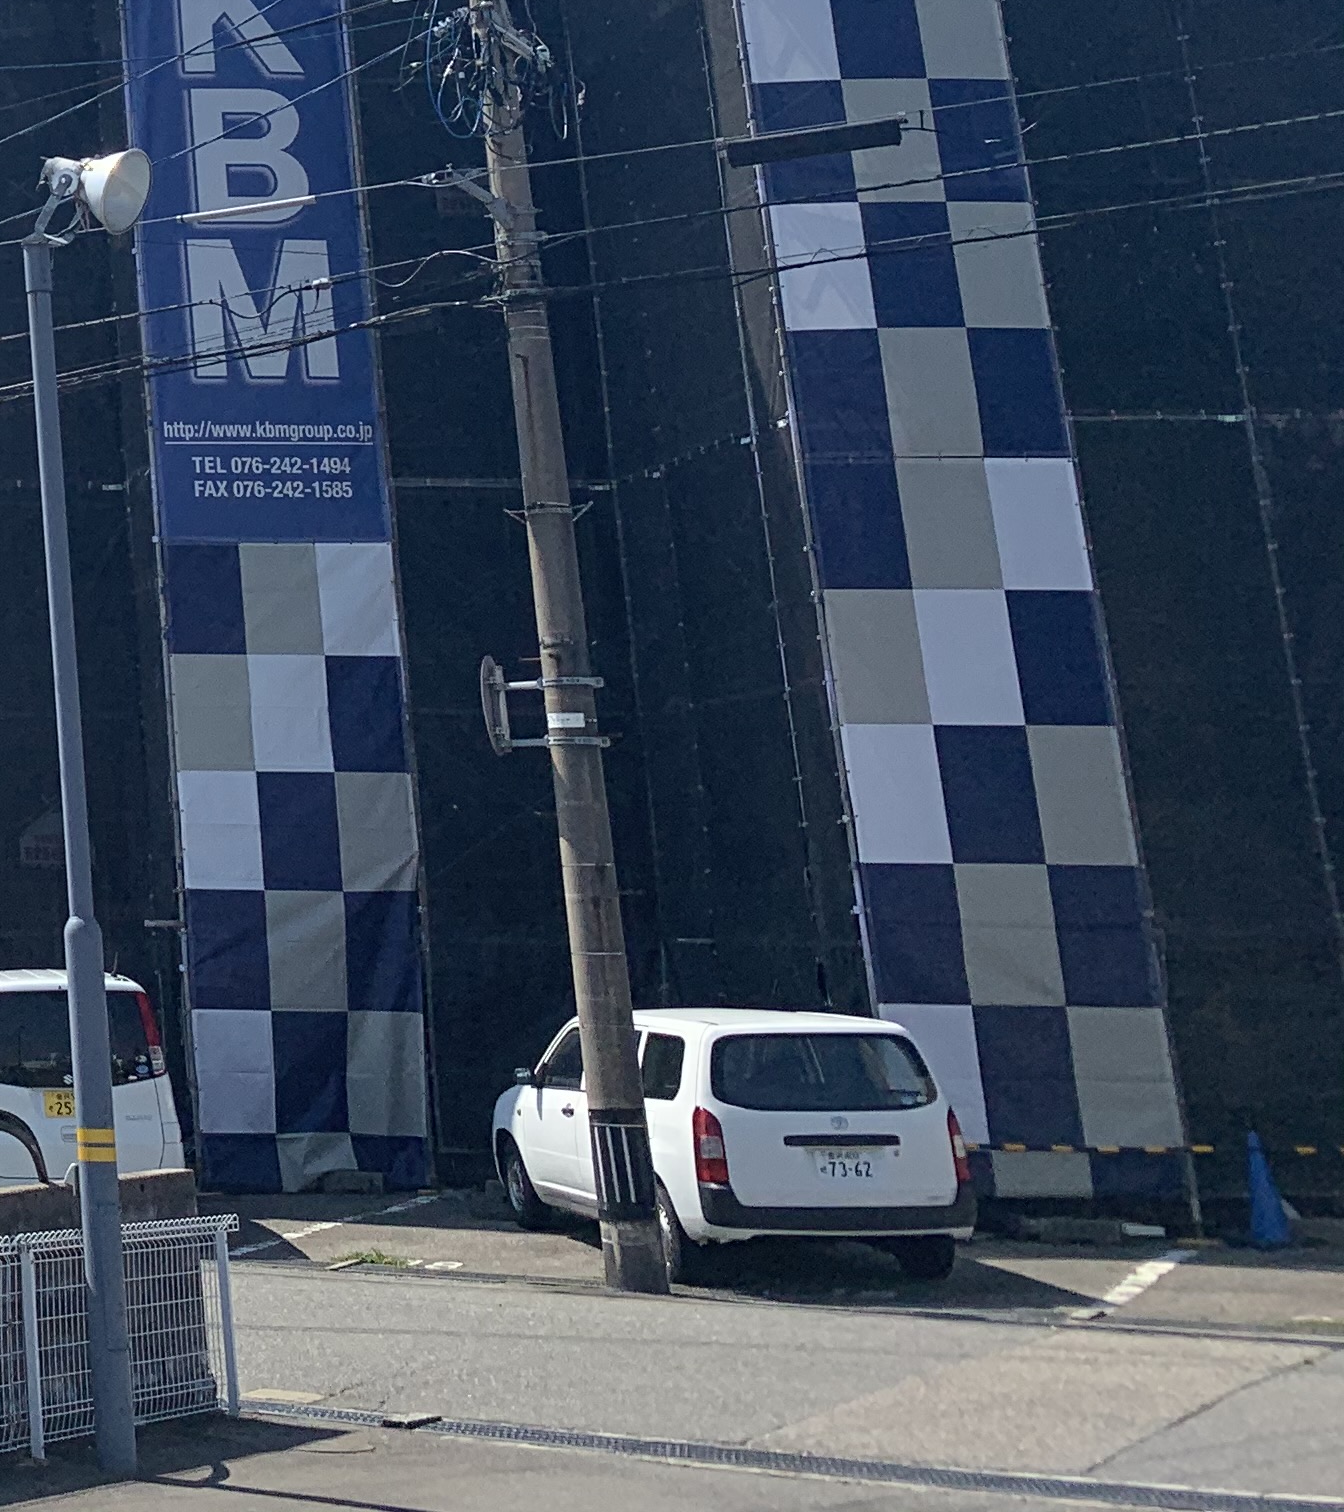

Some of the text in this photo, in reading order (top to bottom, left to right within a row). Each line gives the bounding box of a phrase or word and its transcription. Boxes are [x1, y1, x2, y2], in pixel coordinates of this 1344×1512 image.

[163, 421, 373, 442] http://www.kbmgroup.co.jp
[191, 456, 351, 474] TEL 076-242-1494
[193, 480, 353, 498] FAX 076-242-1585
[828, 1160, 873, 1178] 73-62
